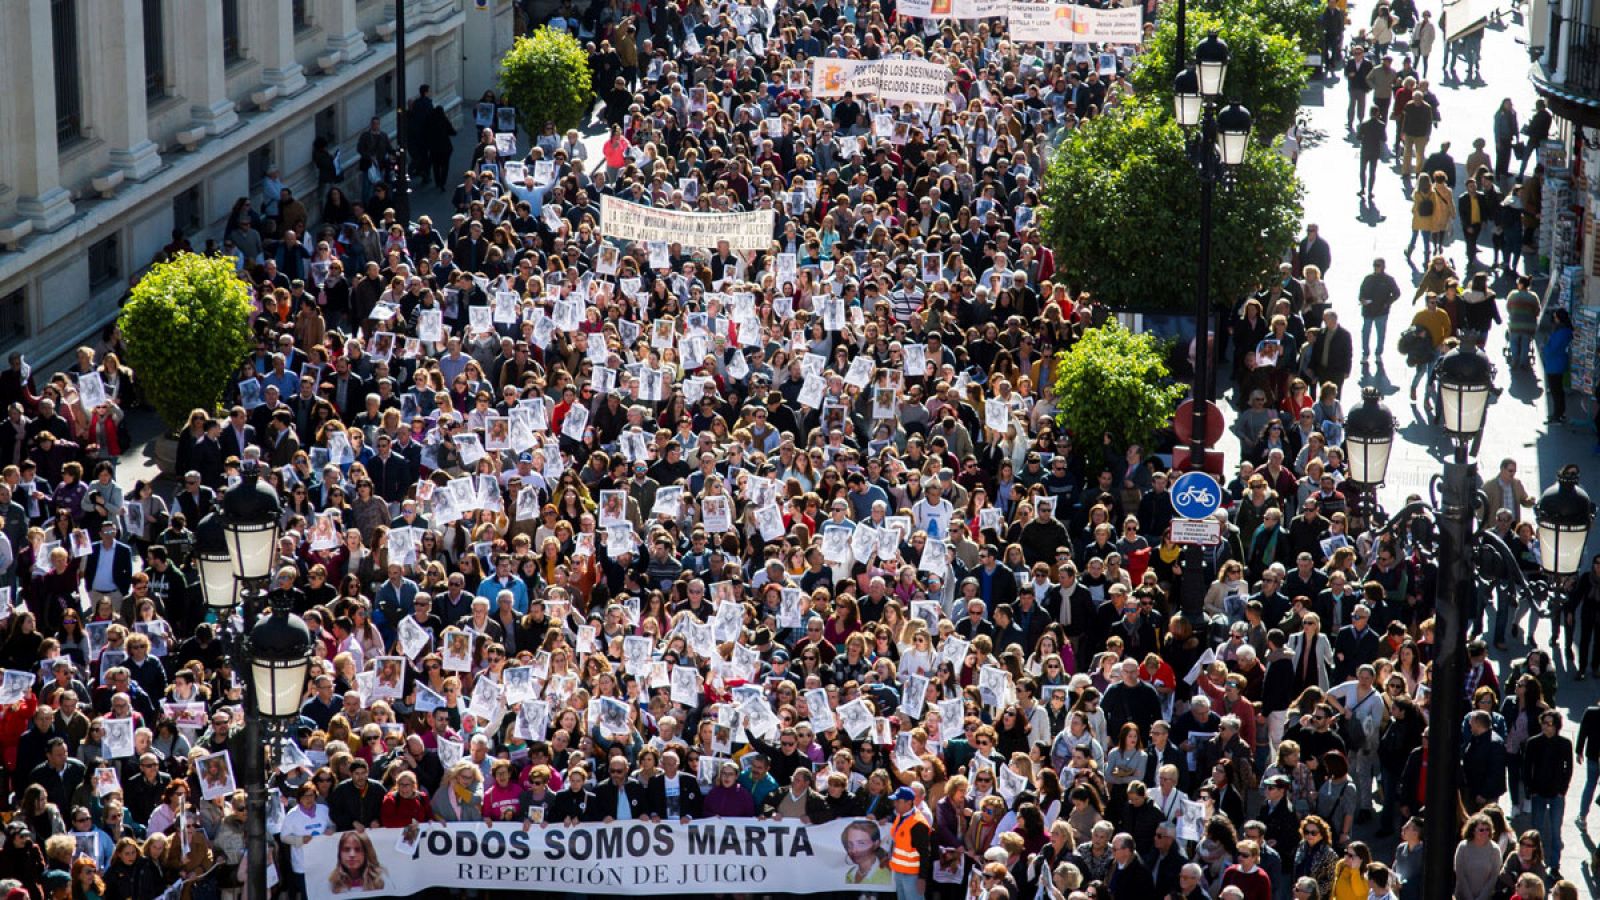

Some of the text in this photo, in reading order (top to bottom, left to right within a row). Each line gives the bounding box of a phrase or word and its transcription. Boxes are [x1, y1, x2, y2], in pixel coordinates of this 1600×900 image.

[853, 63, 947, 81] POR TODOS LOS ASESINADOS
[910, 81, 920, 93] DE
[544, 824, 675, 861] SOMOS
[688, 824, 814, 857] MARTA
[457, 863, 767, 885] REPETICIÓN DE JUICIO
